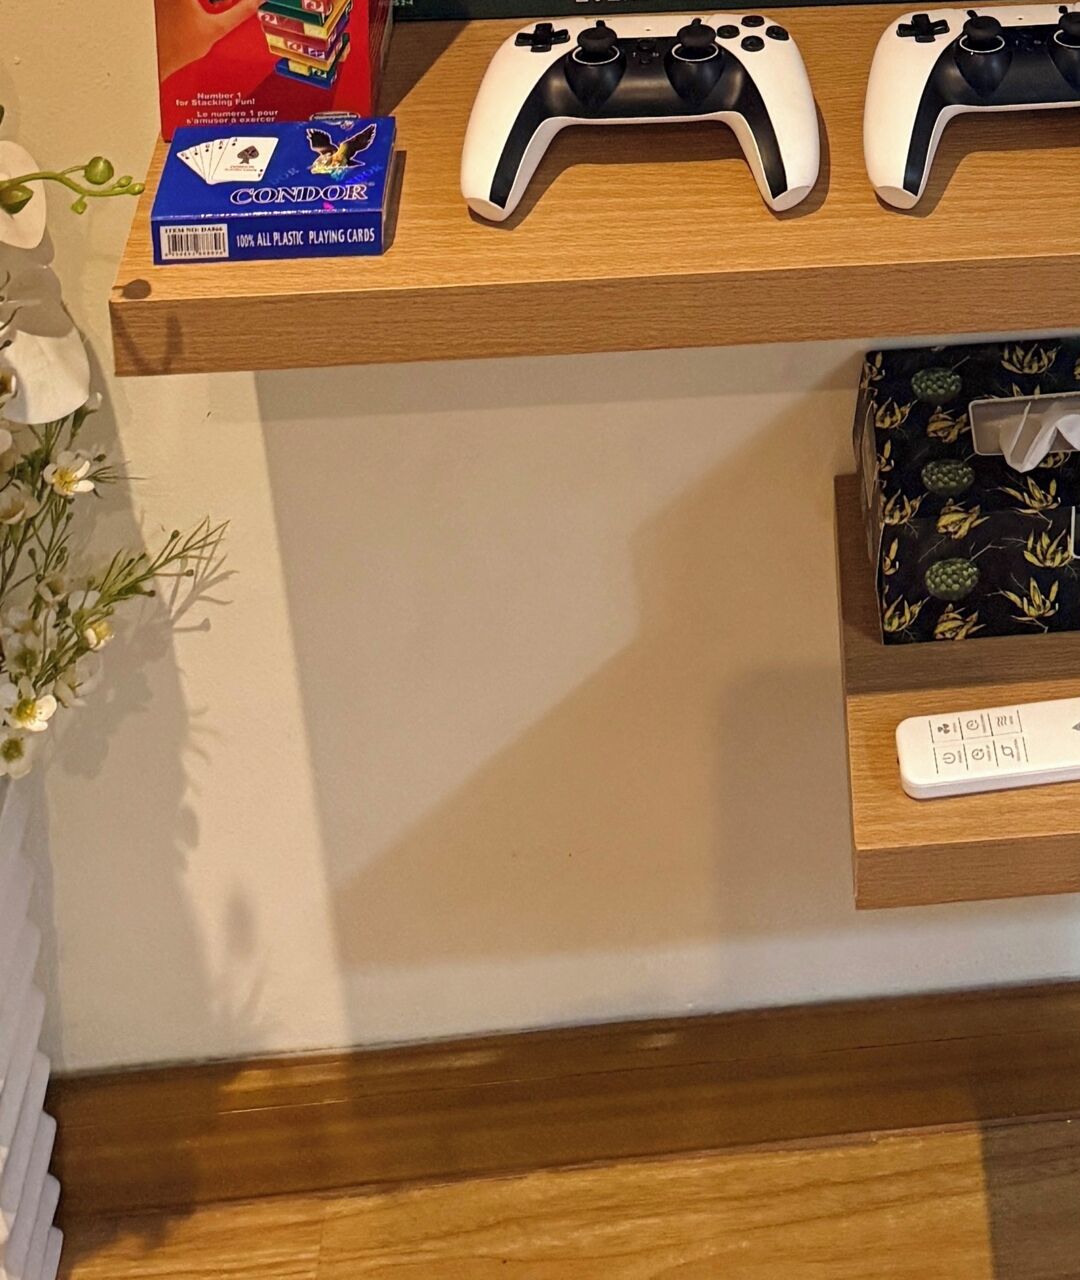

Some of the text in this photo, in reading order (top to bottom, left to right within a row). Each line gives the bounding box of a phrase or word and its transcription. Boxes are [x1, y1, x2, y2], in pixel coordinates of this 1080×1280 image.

[191, 98, 233, 107] Stacking
[197, 92, 234, 100] Number
[229, 184, 369, 205] CONDOR
[235, 227, 375, 248] 100% ALL PLASTIC PLAYING CARDS
